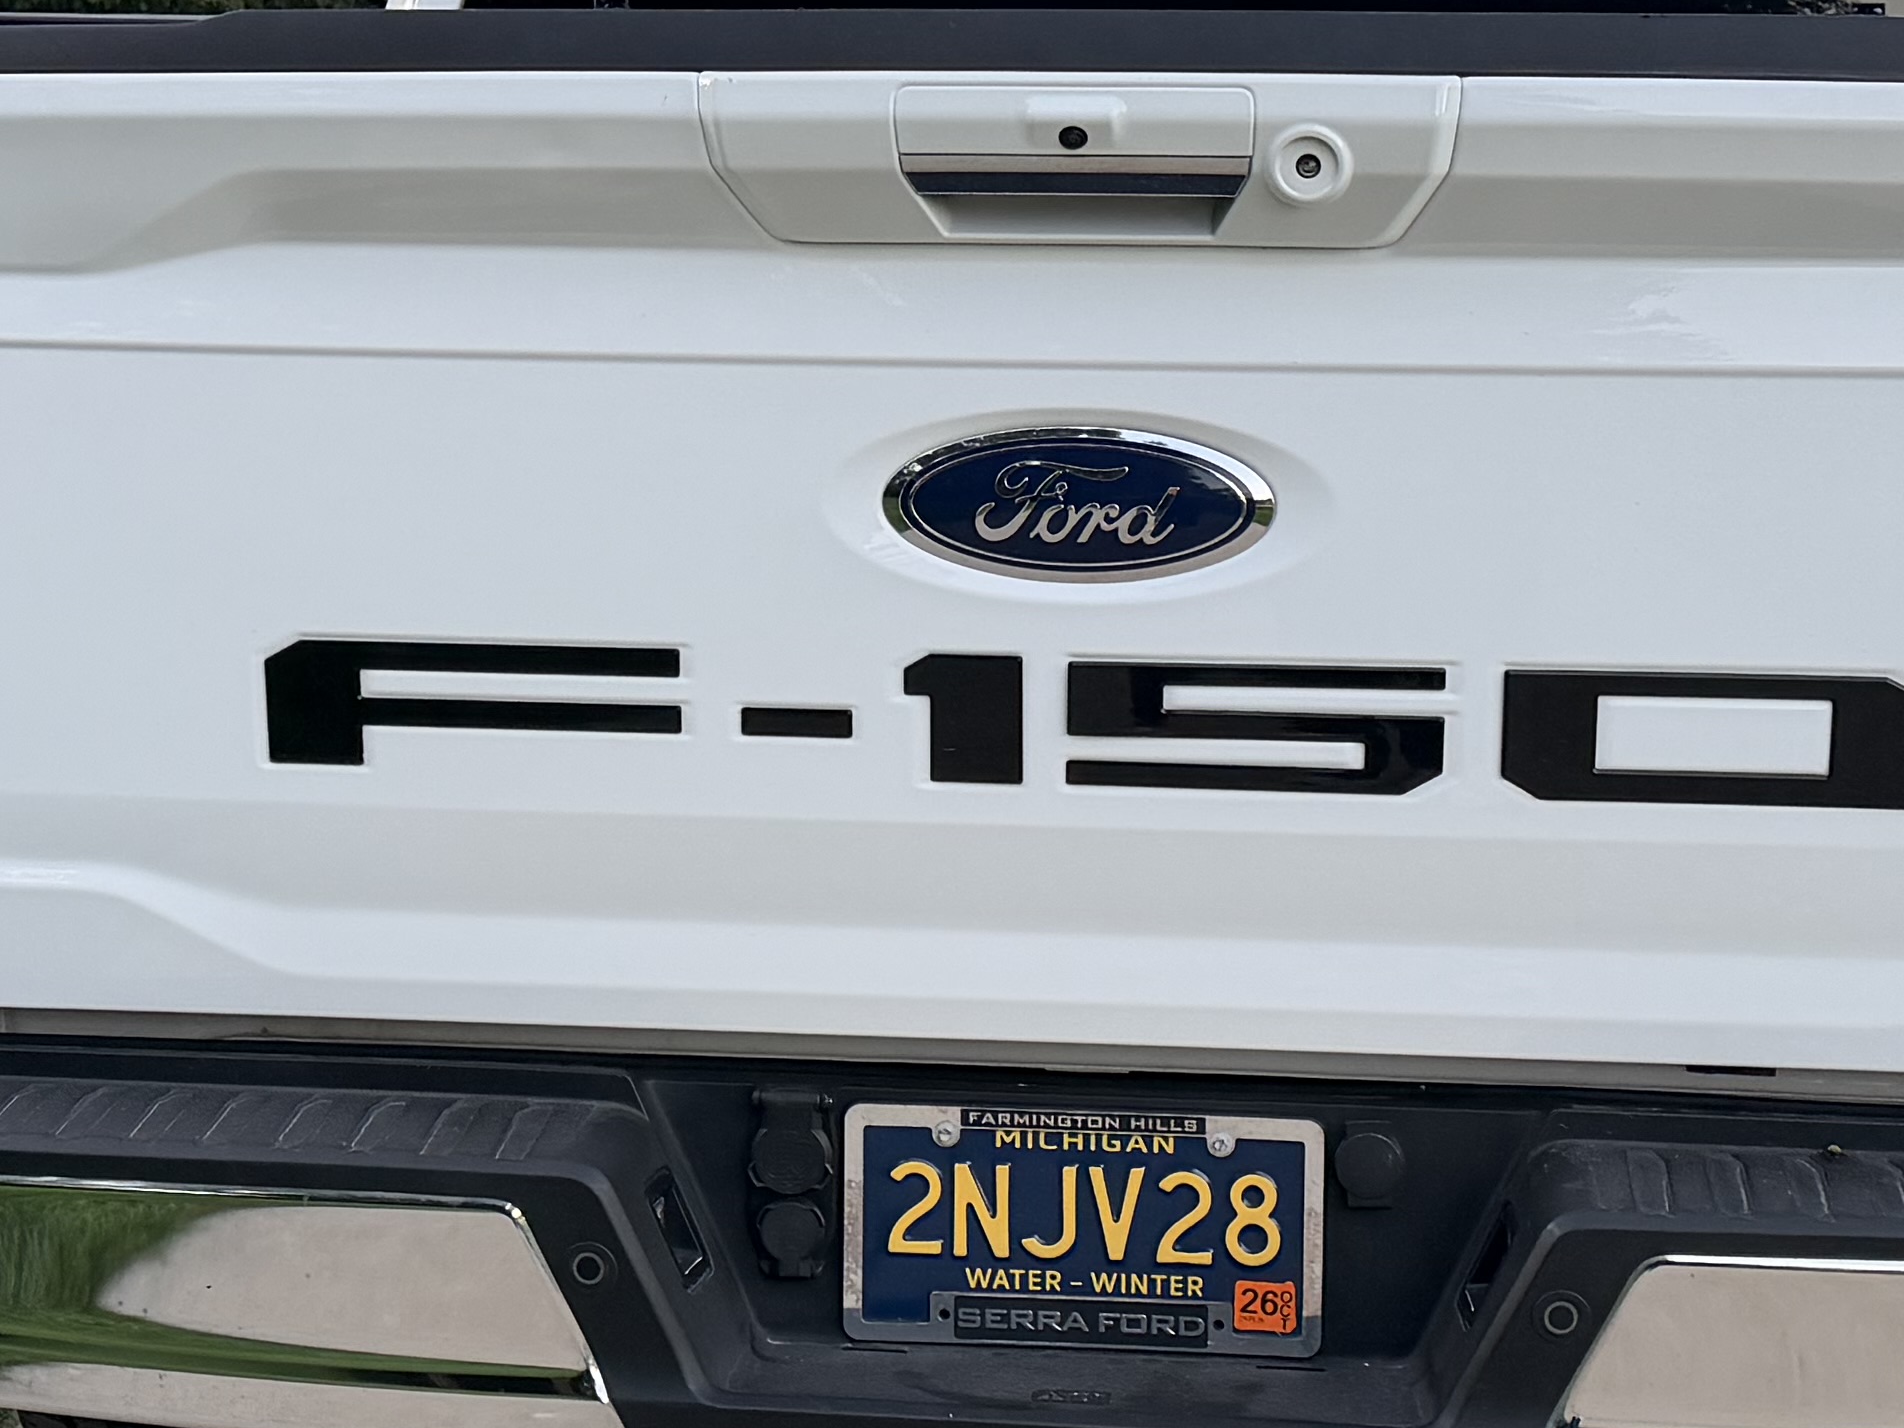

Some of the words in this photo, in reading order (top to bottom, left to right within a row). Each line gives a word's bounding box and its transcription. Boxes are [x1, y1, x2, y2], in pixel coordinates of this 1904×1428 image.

[974, 459, 1181, 546] Ford
[967, 1112, 1120, 1129] FARMINGTON
[1130, 1118, 1198, 1132] HILLS
[995, 1129, 1176, 1155] MICHIGAN
[887, 1160, 1282, 1268] 2NJV28
[965, 1267, 1062, 1292] WATER
[1090, 1271, 1204, 1298] WINTER
[957, 1308, 1090, 1332] SERRA
[1098, 1312, 1206, 1337] FORD
[1240, 1288, 1279, 1316] 26
[1280, 1291, 1293, 1331] OCT
